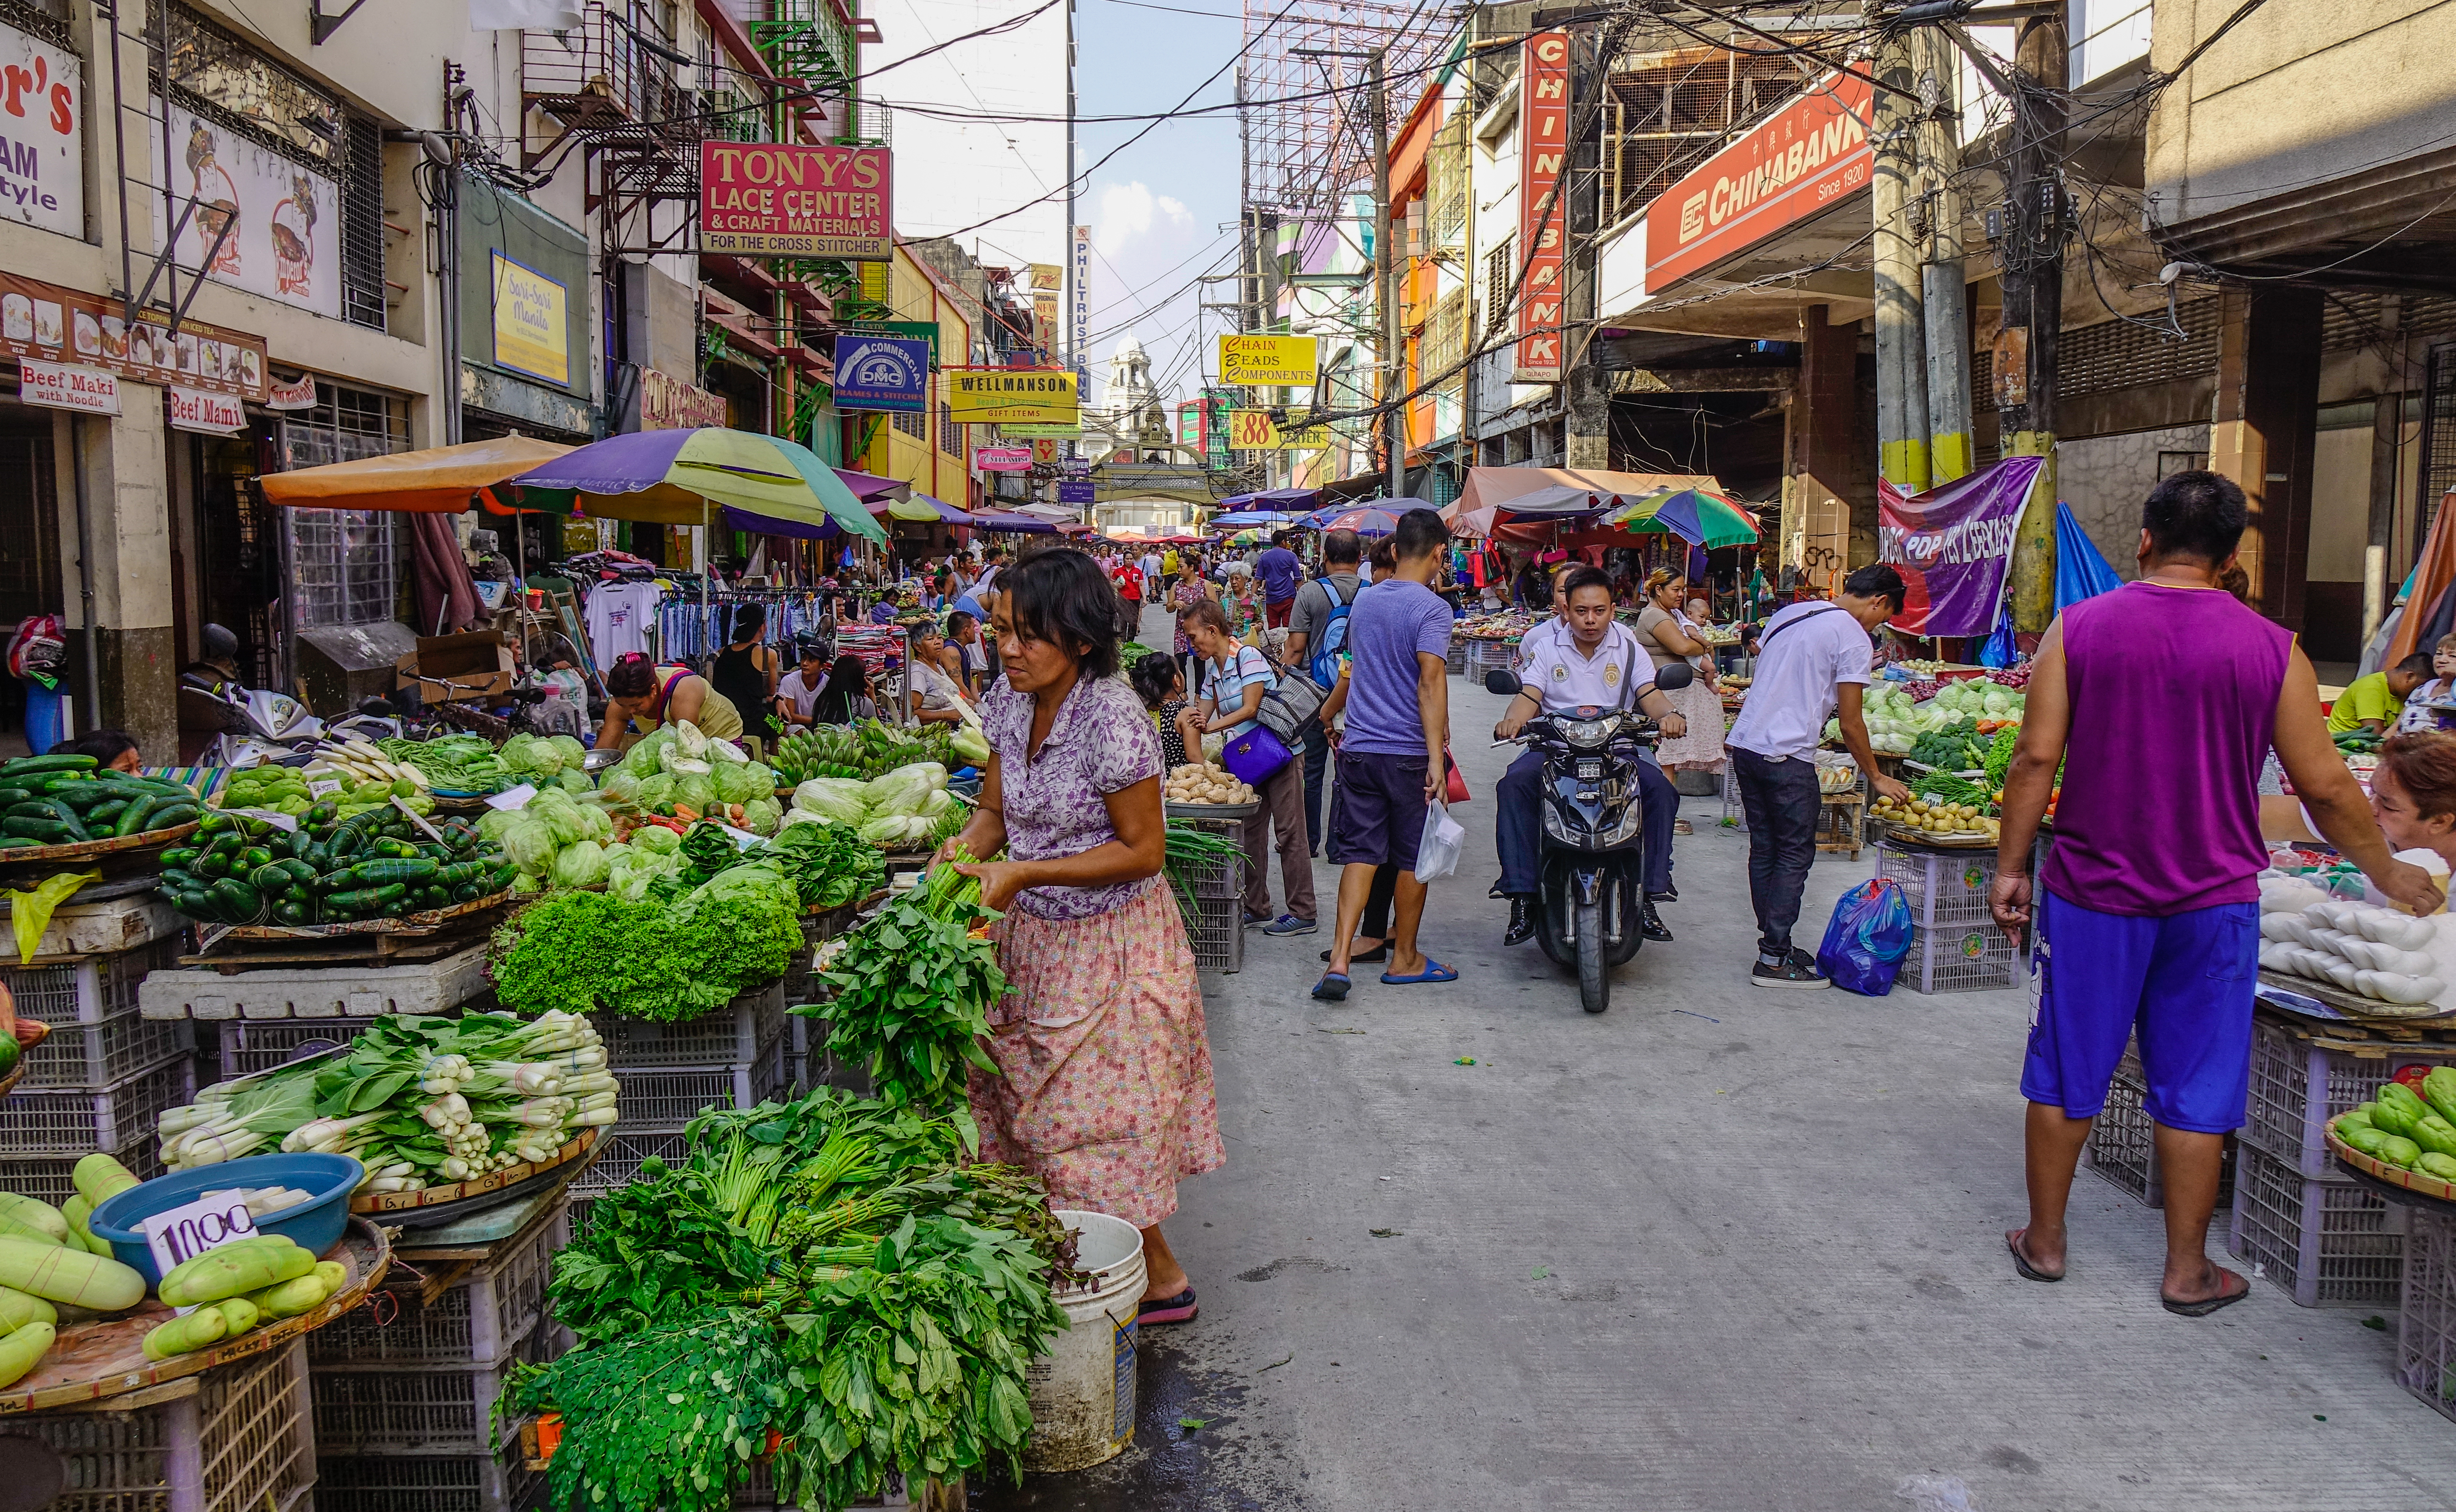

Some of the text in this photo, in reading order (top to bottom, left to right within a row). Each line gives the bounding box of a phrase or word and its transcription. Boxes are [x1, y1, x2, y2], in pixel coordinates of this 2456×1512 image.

[0, 55, 73, 135] r's
[1709, 98, 1869, 225] CHINABANK
[1818, 163, 1864, 201] Since 1920
[711, 187, 880, 218] LACE CENTER
[711, 214, 880, 237] & CRAFT MATERIALS
[740, 236, 764, 249] THE
[769, 237, 812, 251] CROSS
[509, 273, 552, 310] Sari-Sari
[1077, 243, 1087, 349] PHILTRUST
[514, 300, 549, 331] Manila
[1036, 303, 1057, 313] NEW
[190, 323, 203, 333] ICED
[203, 326, 214, 335] TEA
[1225, 337, 1276, 352] CHAIN
[871, 342, 922, 390] COMMERCIAL
[1225, 353, 1280, 367] BEADS
[23, 366, 114, 395] Beef Maki
[861, 371, 901, 383] DMC
[961, 378, 1067, 392] WELLMANSON
[1077, 354, 1087, 399] BANK
[1225, 367, 1313, 382] COMPONENTS
[36, 390, 104, 407] with Noodle
[835, 390, 871, 398] FRAMES
[883, 392, 924, 400] STITCHES
[172, 393, 241, 426] Beef Mami
[1242, 413, 1270, 444] 88
[1322, 465, 1334, 482] CENTER
[1906, 535, 1942, 560] PDP
[313, 783, 336, 791] SAYOTE
